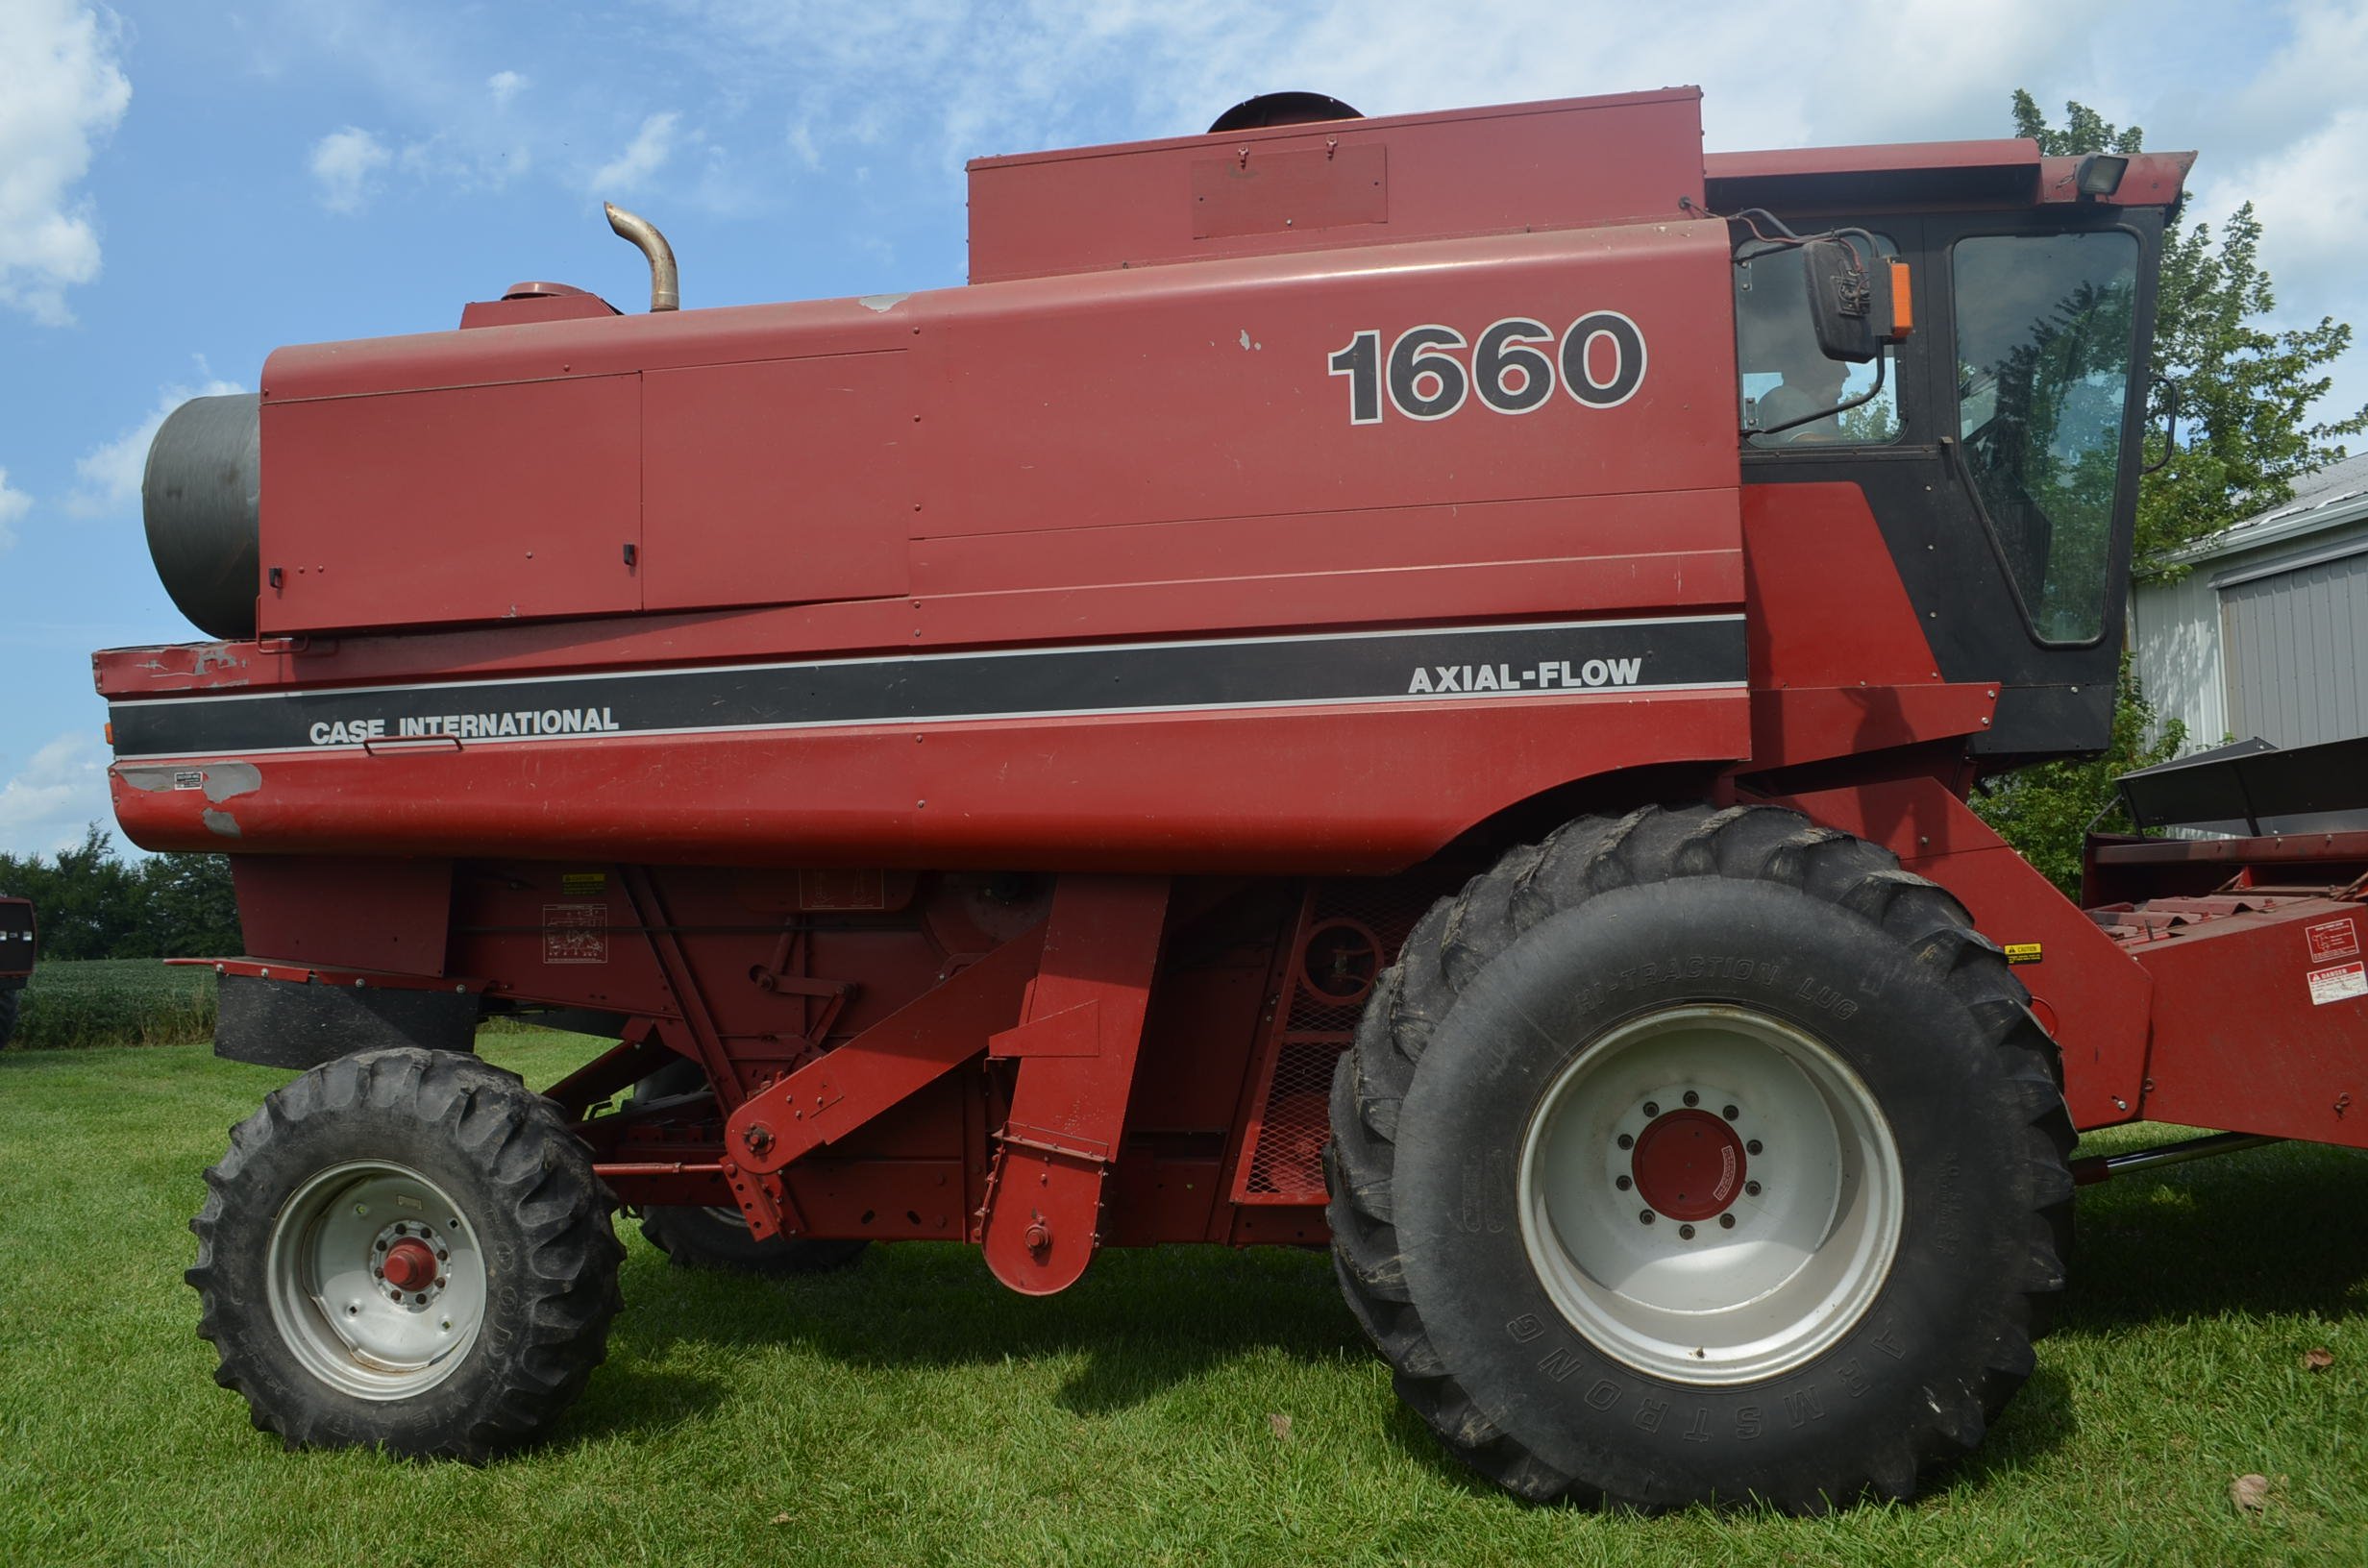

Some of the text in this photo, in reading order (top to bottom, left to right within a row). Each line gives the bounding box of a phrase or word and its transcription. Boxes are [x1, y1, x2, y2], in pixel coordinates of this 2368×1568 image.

[1327, 309, 1648, 426] 1660
[1408, 658, 1641, 694] AXIAL-FLOW
[309, 707, 619, 746] CASE INTERNATIONAL
[1572, 955, 1860, 1022] HI-TRACTION LUG
[2320, 968, 2348, 979] DANGER
[1506, 1311, 1908, 1444] ARMSTRONG
